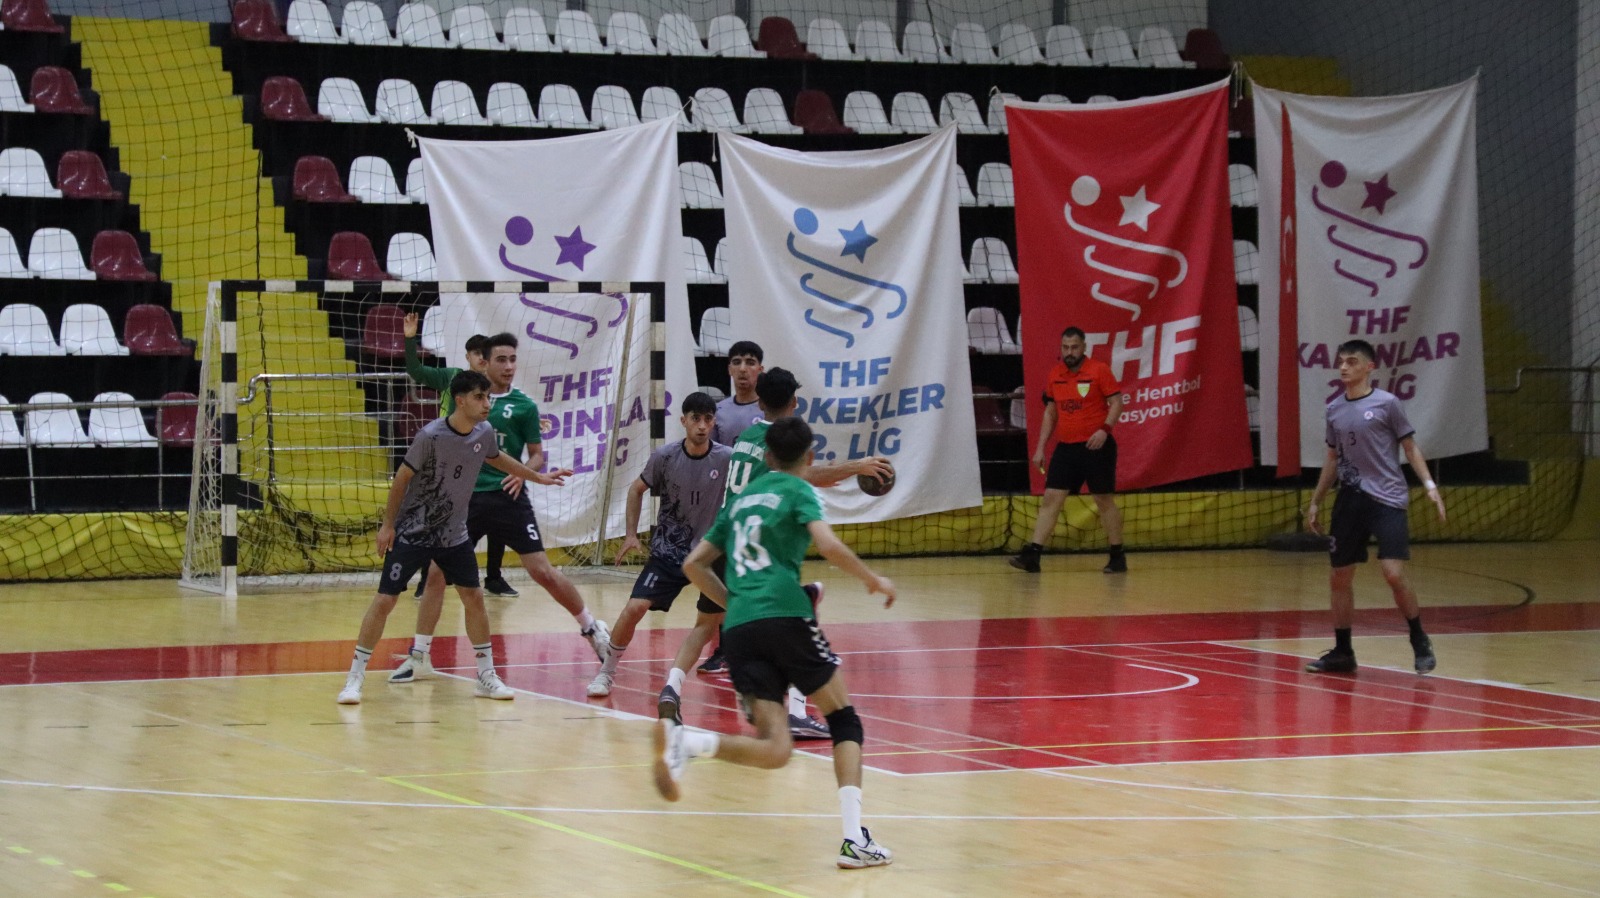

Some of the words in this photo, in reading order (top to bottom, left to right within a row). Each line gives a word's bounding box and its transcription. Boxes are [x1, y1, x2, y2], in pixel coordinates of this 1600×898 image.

[1346, 305, 1411, 335] THF
[1296, 332, 1460, 369] KANLAR
[539, 367, 613, 403] THF
[818, 356, 892, 388] THF
[1370, 368, 1417, 401] İG
[1136, 374, 1201, 403] Hentbol
[502, 403, 515, 419] 5
[794, 383, 945, 424] RKEKLER
[1118, 401, 1184, 424] asyonu
[812, 434, 836, 460] 2.
[847, 421, 902, 460] LİG
[1348, 431, 1357, 446] 3
[453, 464, 463, 480] 8
[690, 490, 700, 506] 11
[526, 523, 540, 541] 5
[389, 562, 403, 581] 8
